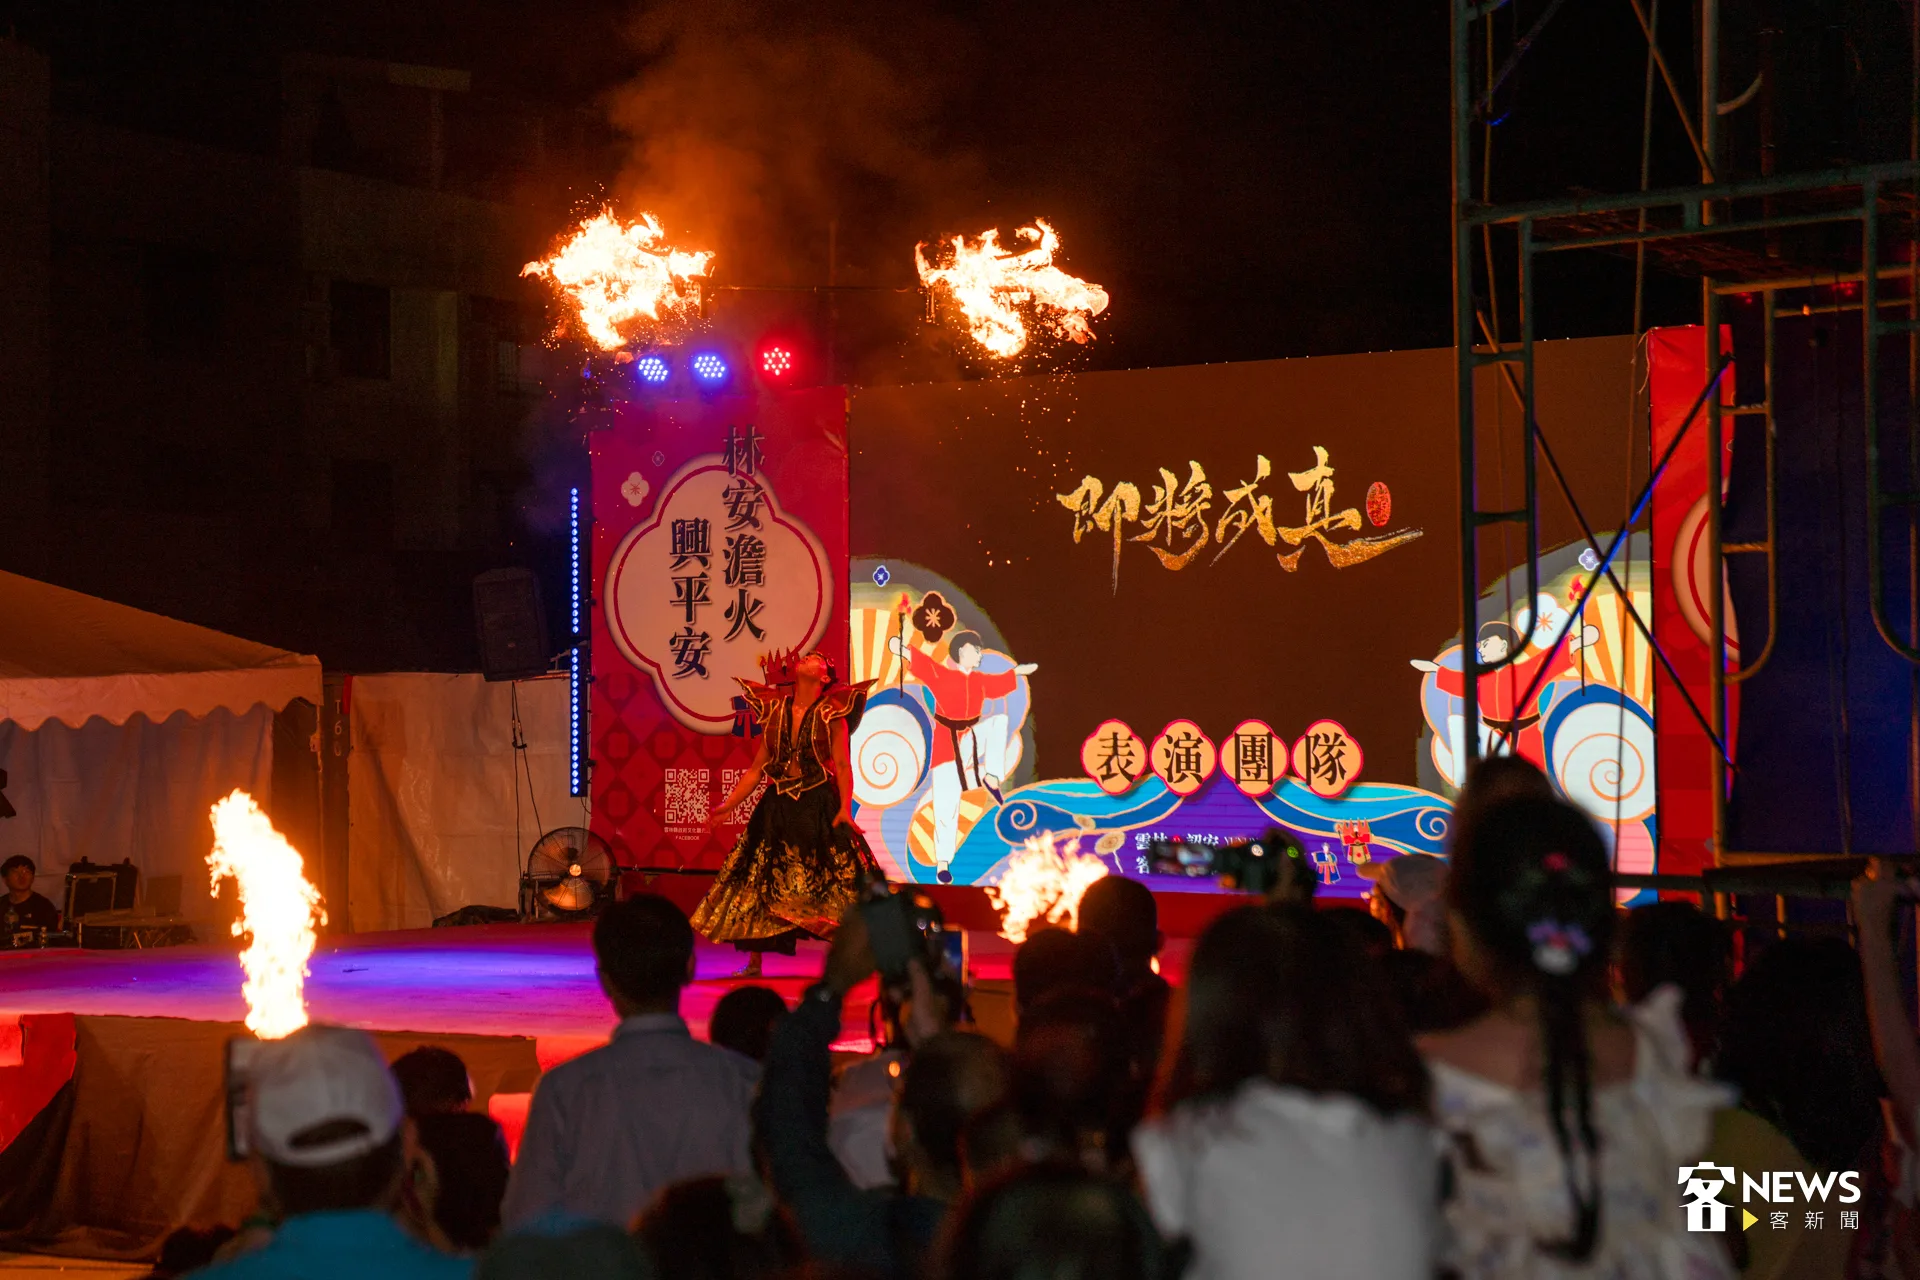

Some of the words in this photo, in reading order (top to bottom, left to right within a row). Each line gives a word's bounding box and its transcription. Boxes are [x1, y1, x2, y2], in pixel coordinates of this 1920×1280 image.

[669, 517, 713, 678] 興平安
[722, 424, 765, 642] 林安澹火
[1056, 446, 1424, 597] 即將成真
[1096, 731, 1348, 787] 表演團隊
